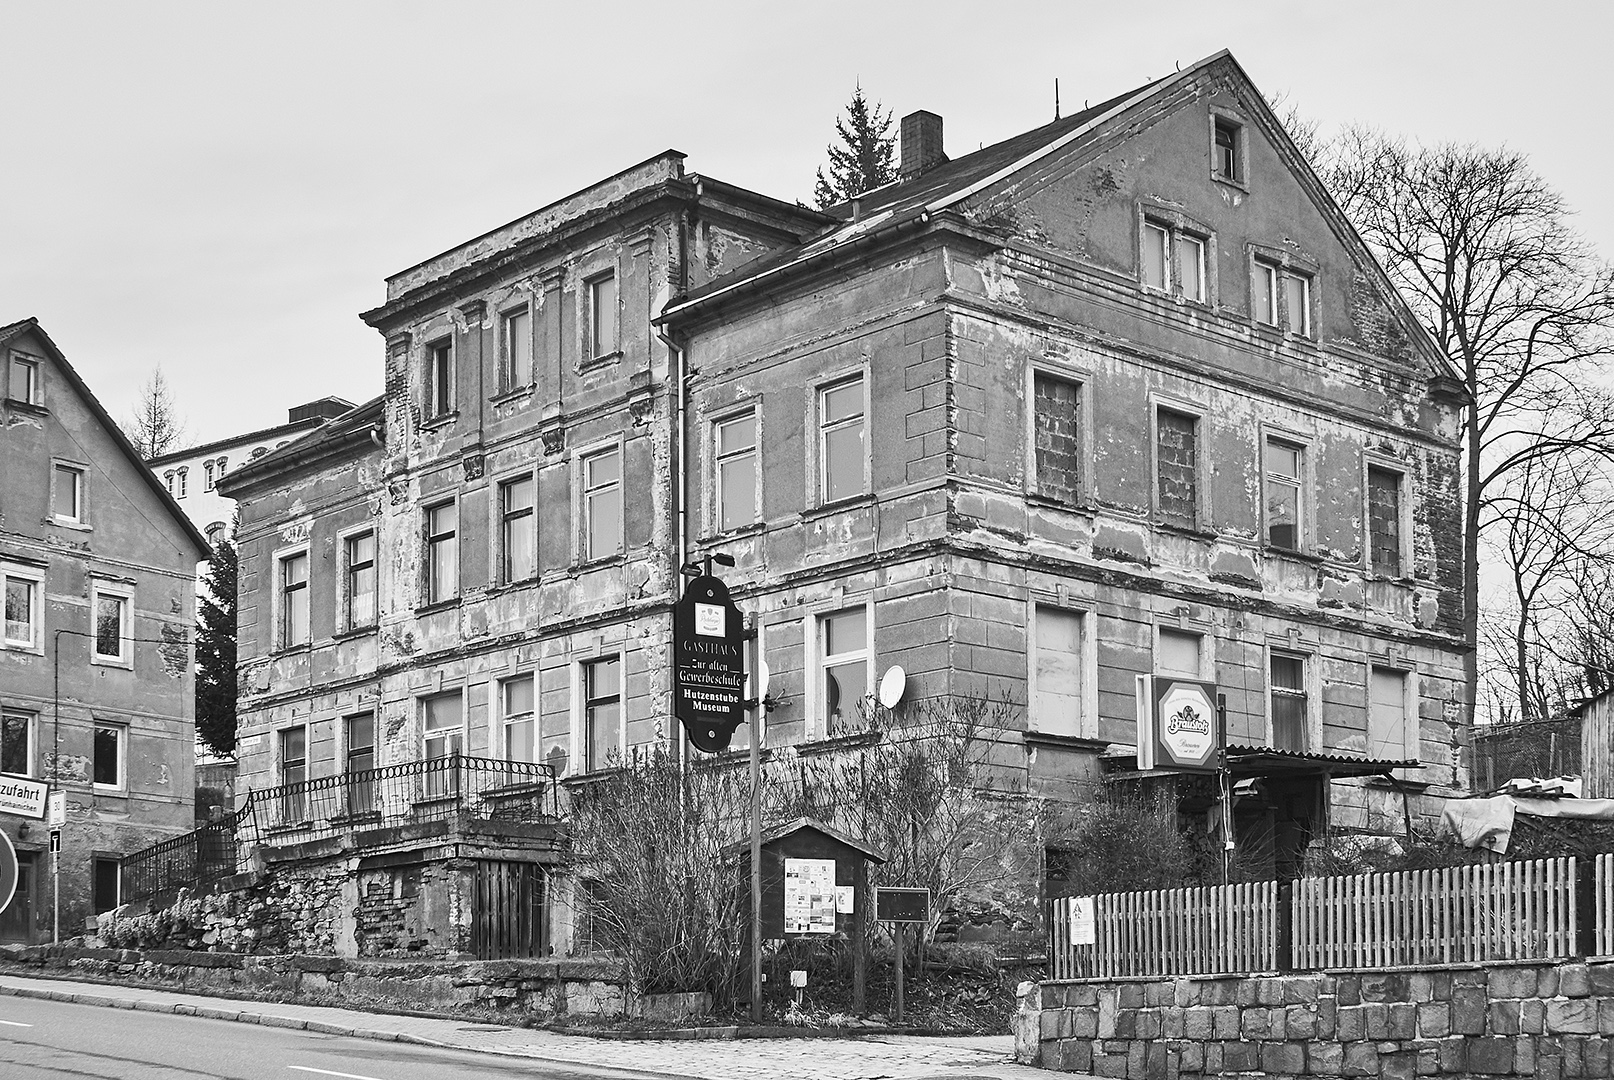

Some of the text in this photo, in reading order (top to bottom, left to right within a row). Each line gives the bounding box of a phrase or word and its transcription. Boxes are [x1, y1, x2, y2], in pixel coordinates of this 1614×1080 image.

[683, 640, 737, 656] GASTHAUS
[708, 659, 728, 672] alten
[679, 670, 741, 687] Gewerbeschule
[683, 688, 739, 703] Hutzenstube
[692, 700, 730, 713] Museum
[0, 783, 40, 801] zufahrt
